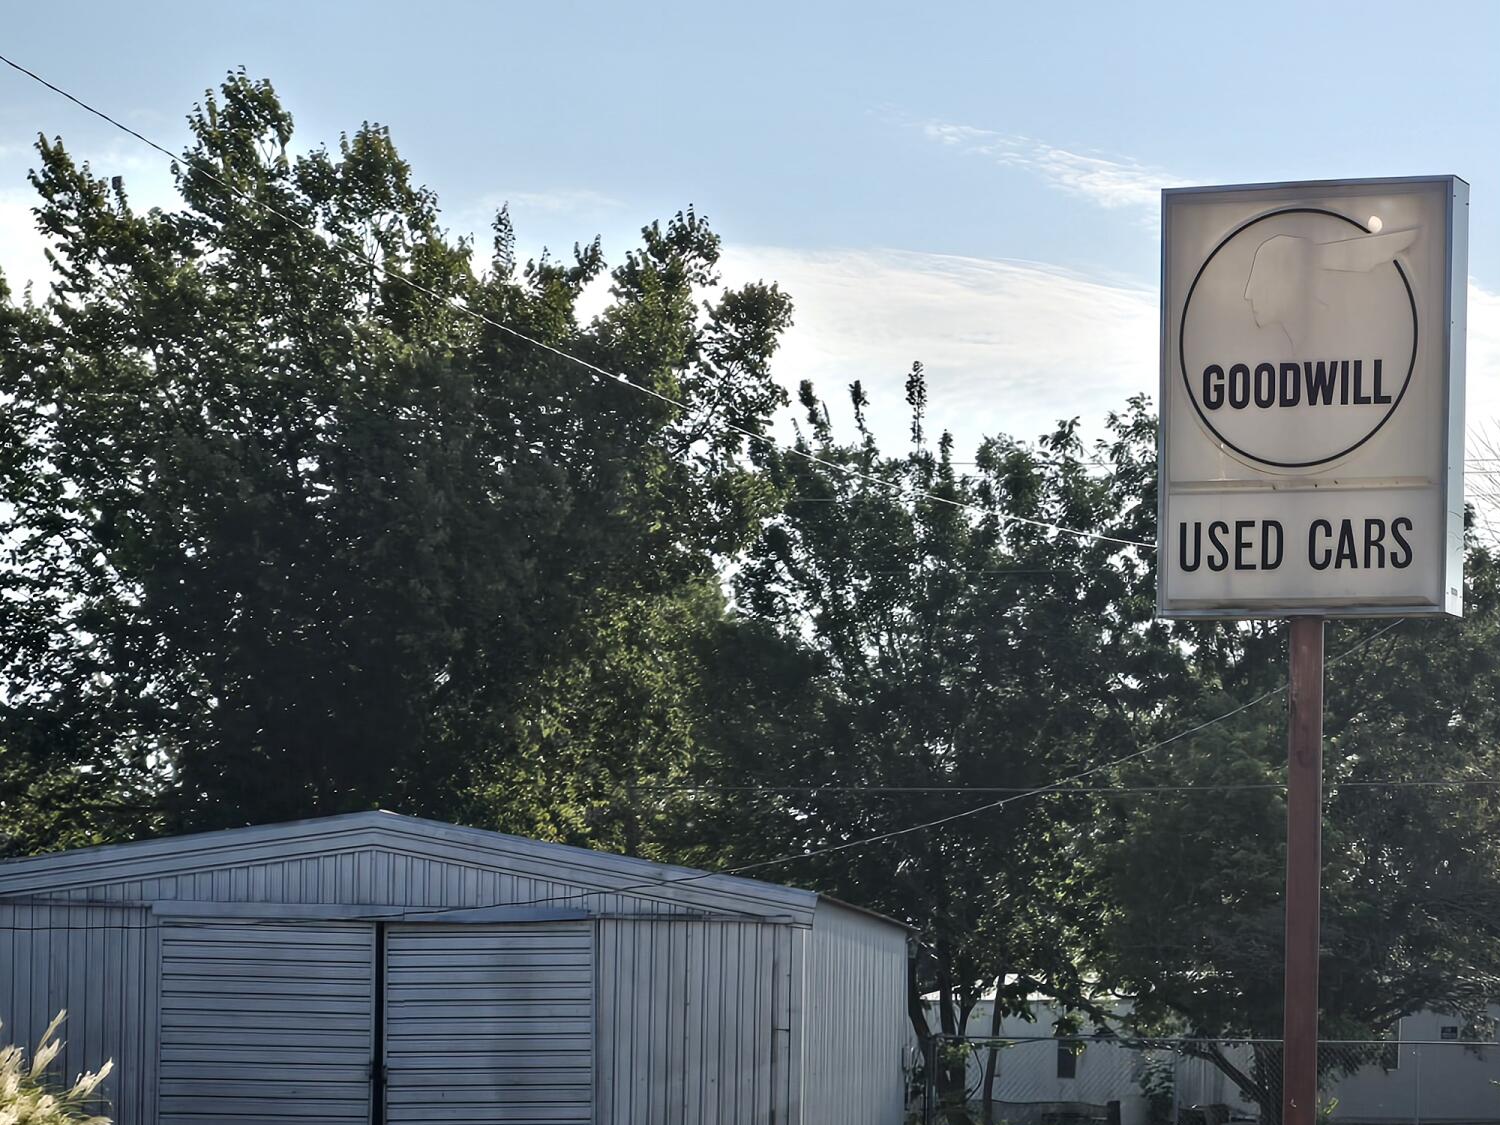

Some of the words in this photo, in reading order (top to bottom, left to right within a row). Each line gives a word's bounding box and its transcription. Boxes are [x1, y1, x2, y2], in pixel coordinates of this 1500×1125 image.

[1202, 359, 1392, 410] GOODWILL
[1179, 520, 1284, 572] USED
[1308, 517, 1413, 570] CARS
